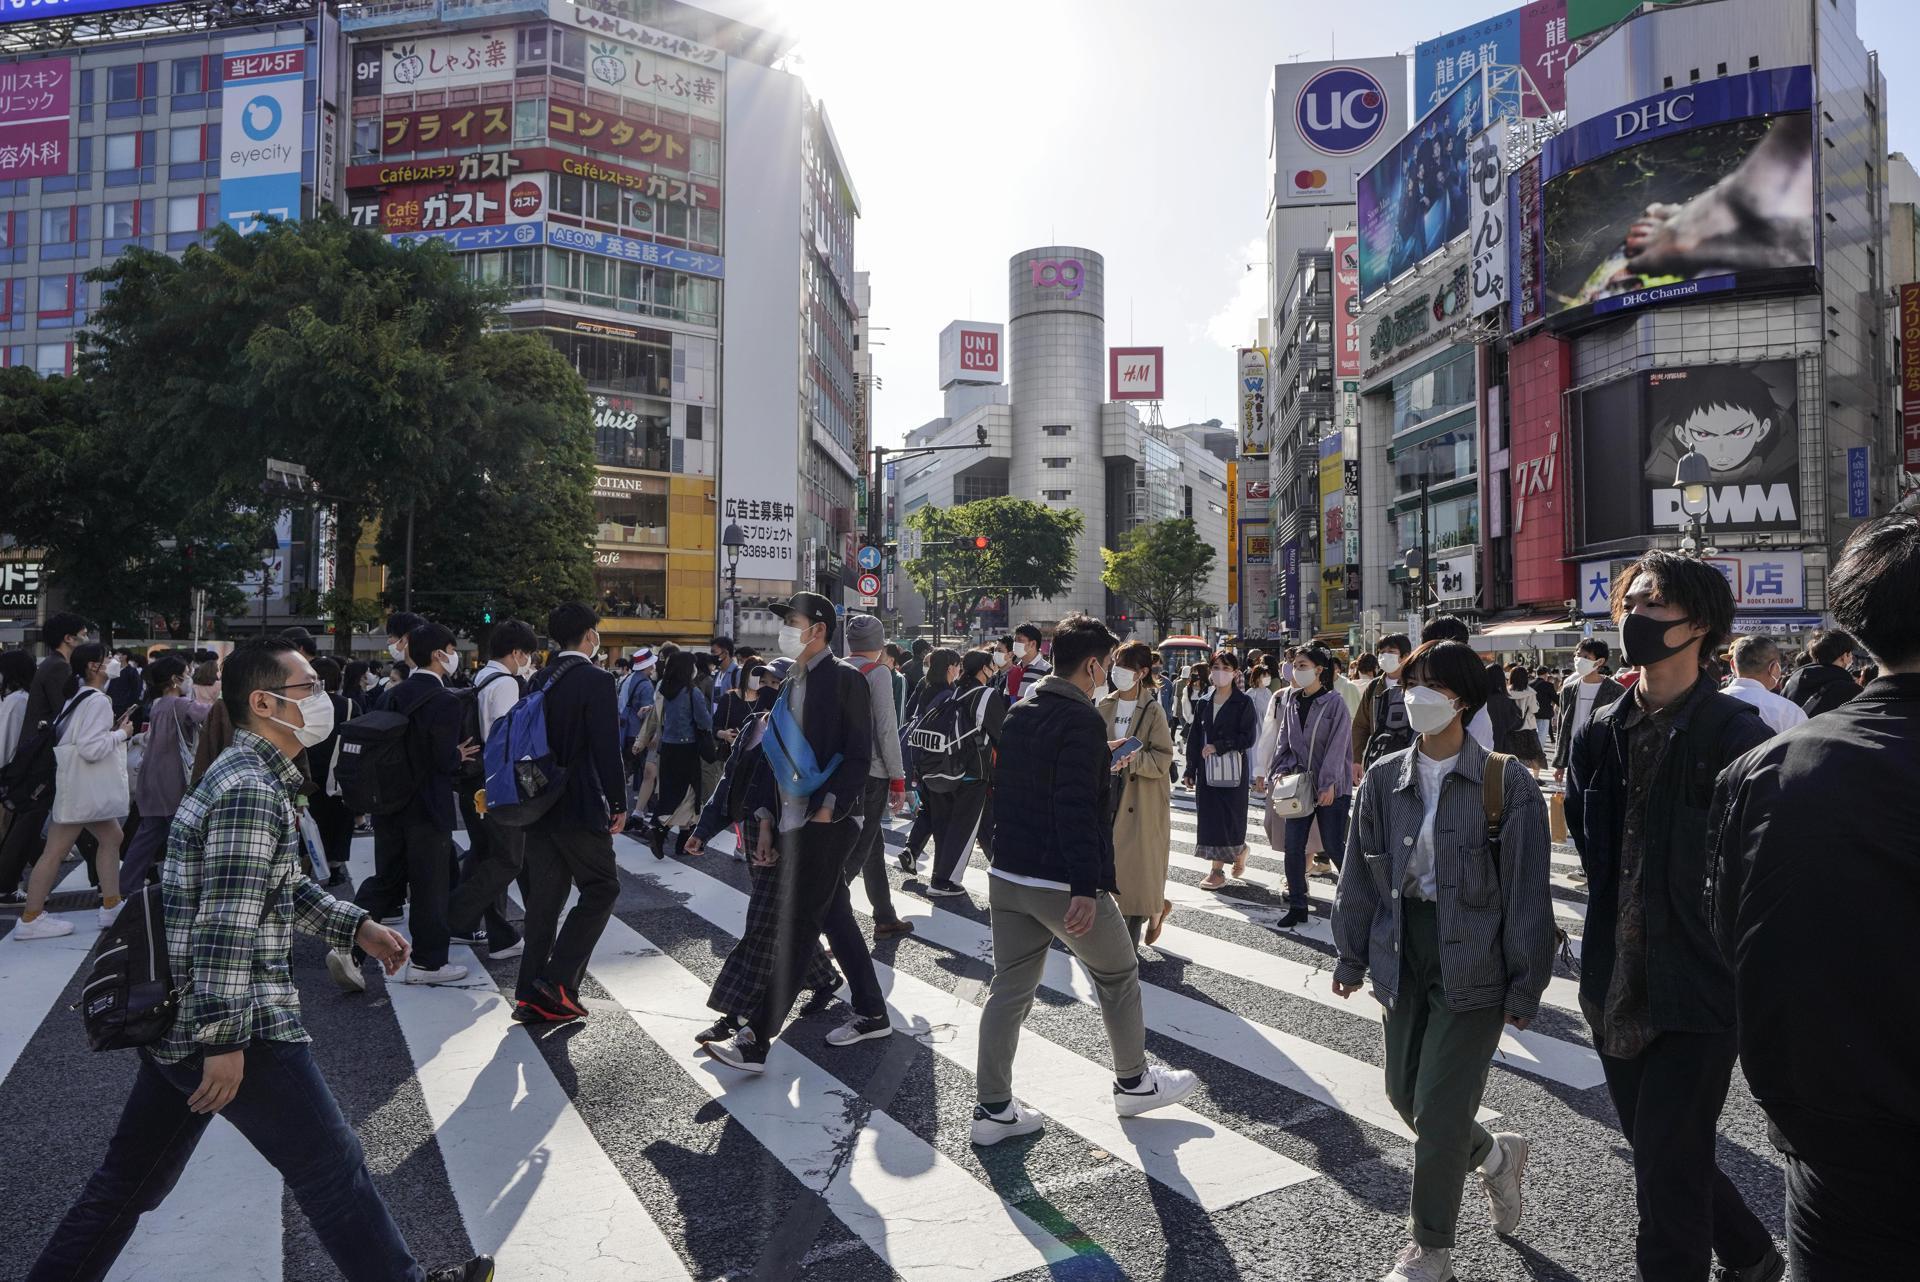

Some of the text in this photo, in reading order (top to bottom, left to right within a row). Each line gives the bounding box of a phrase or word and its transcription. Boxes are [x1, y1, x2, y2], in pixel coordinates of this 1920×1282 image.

[232, 54, 296, 77] 当ビル5F
[429, 40, 507, 74] しゃぶ葉
[1, 70, 63, 93] 川スキン
[357, 62, 380, 80] 9F
[635, 59, 716, 104] しゃぶ葉
[386, 107, 508, 145] プライス
[1613, 92, 1695, 139] DHC
[550, 105, 685, 160] コンタクト
[0, 140, 62, 169] 容外科
[230, 143, 292, 167] eyecity
[458, 152, 520, 181] ガスト
[513, 196, 539, 208] ガスト
[647, 175, 707, 206] ガスト
[351, 204, 379, 226] 7F
[386, 202, 419, 217] Café
[423, 192, 499, 229] ガスト
[1472, 133, 1504, 301] もんじゃ
[516, 228, 533, 241] 6F
[555, 229, 720, 273] AEON 英会話イーオン
[1029, 258, 1085, 300] 109
[1622, 282, 1698, 306] DHC Channel
[965, 335, 992, 351] UNI
[965, 351, 994, 368] QLO
[725, 497, 794, 523] 広告主募集中
[741, 525, 792, 542] ミプロジェクト
[592, 551, 620, 565] Café
[1589, 572, 1608, 602] 大
